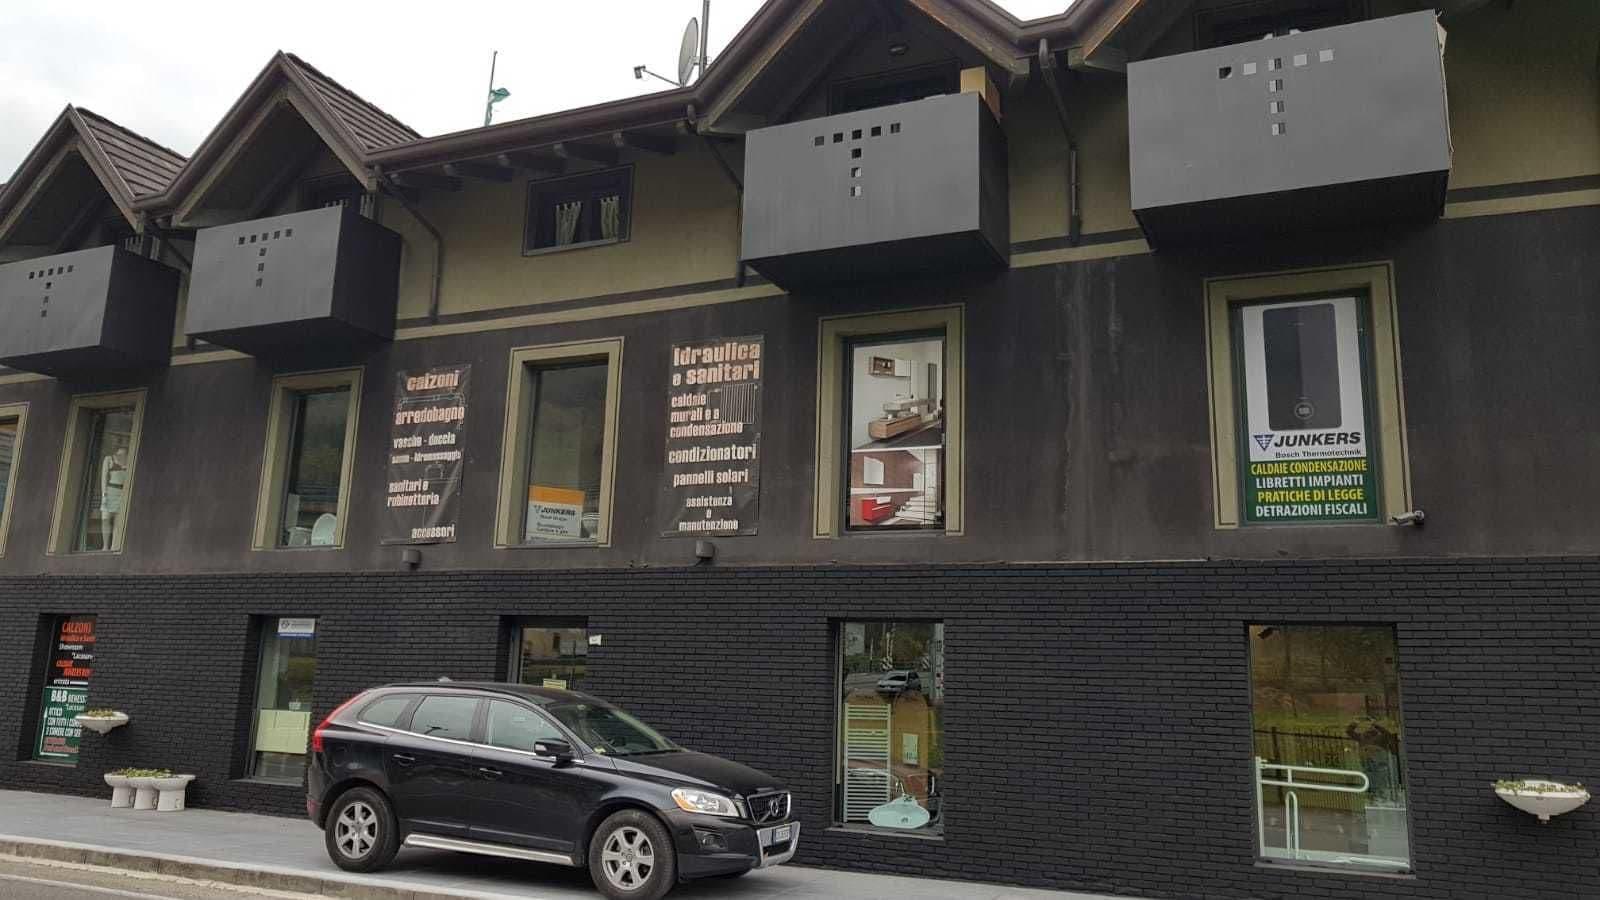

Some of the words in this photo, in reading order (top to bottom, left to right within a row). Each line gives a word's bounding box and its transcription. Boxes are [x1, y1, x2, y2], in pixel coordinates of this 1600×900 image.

[406, 370, 460, 391] calzoni
[686, 360, 760, 385] sanitari
[671, 392, 706, 408] caldaie
[395, 406, 465, 425] arredobagno
[670, 407, 703, 423] murali
[705, 408, 711, 420] e
[669, 422, 743, 438] condensazione
[393, 435, 423, 449] vasche
[428, 432, 456, 446] doccia
[1274, 431, 1362, 448] JUNKERS
[668, 443, 757, 464] condizionatori
[1275, 450, 1300, 459] Bosch
[673, 470, 715, 487] pannelli
[716, 463, 749, 483] solari
[1251, 462, 1289, 475] CALDAIE
[1290, 459, 1368, 474] CONDENSAZIONE
[388, 478, 422, 493] sanitari
[1256, 476, 1306, 489] LIBRETTI
[1308, 474, 1363, 487] IMPIANTI
[686, 496, 733, 508] assistenza
[1258, 490, 1311, 503] PRATICHE
[1313, 489, 1326, 502] DI
[1328, 488, 1364, 501] LEGGE
[541, 506, 576, 516] JUNKERS
[1255, 504, 1322, 517] DETRAZIONI
[1325, 502, 1368, 515] FISCALI
[411, 523, 455, 539] accessori
[678, 517, 739, 531] manutenzione
